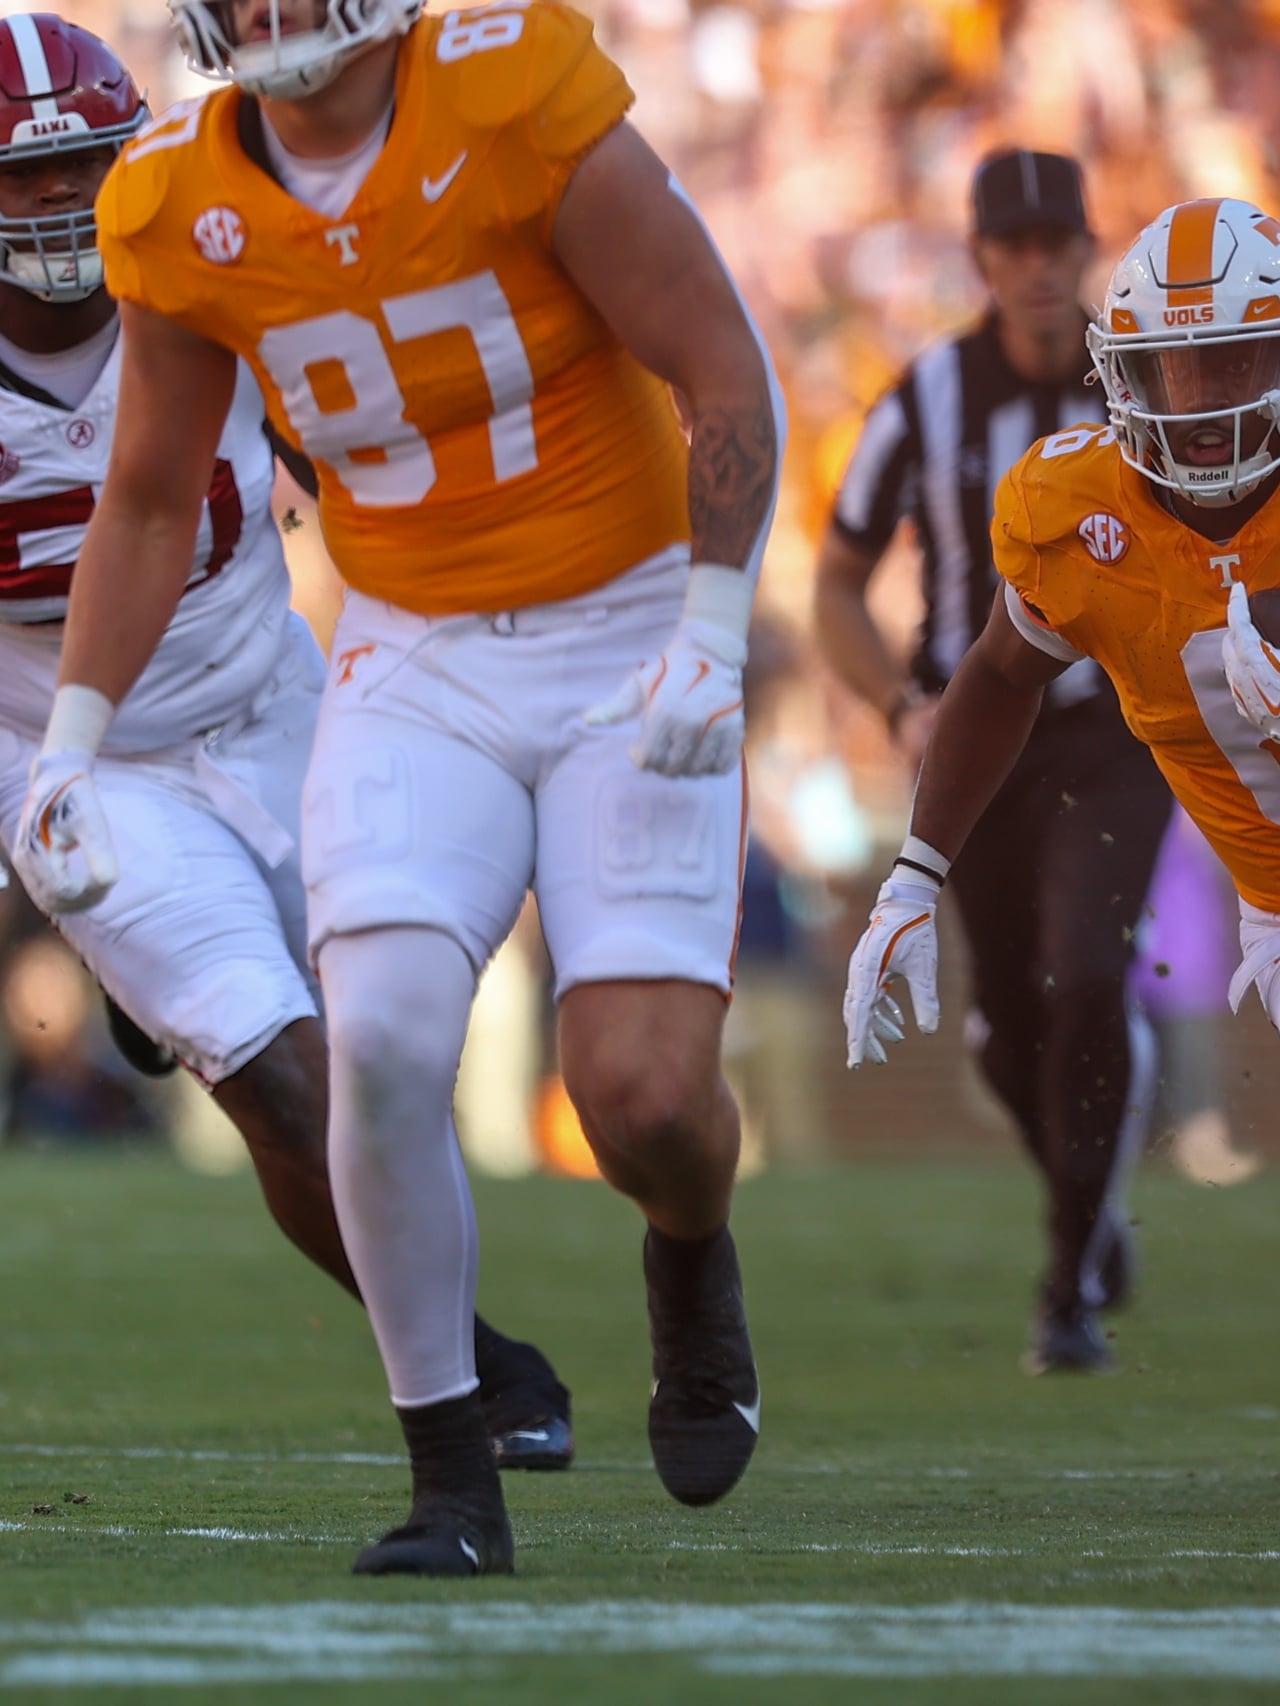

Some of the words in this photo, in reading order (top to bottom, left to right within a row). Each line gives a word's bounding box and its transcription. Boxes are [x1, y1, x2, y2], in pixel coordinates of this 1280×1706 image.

[30, 118, 72, 137] BAMA
[192, 206, 245, 265] SEC
[325, 223, 360, 267] T
[1163, 306, 1214, 327] VOLS
[257, 269, 539, 507] 87
[1188, 470, 1229, 482] Riddell
[1077, 513, 1126, 562] SEC
[1209, 554, 1241, 588] T
[337, 643, 377, 687] T
